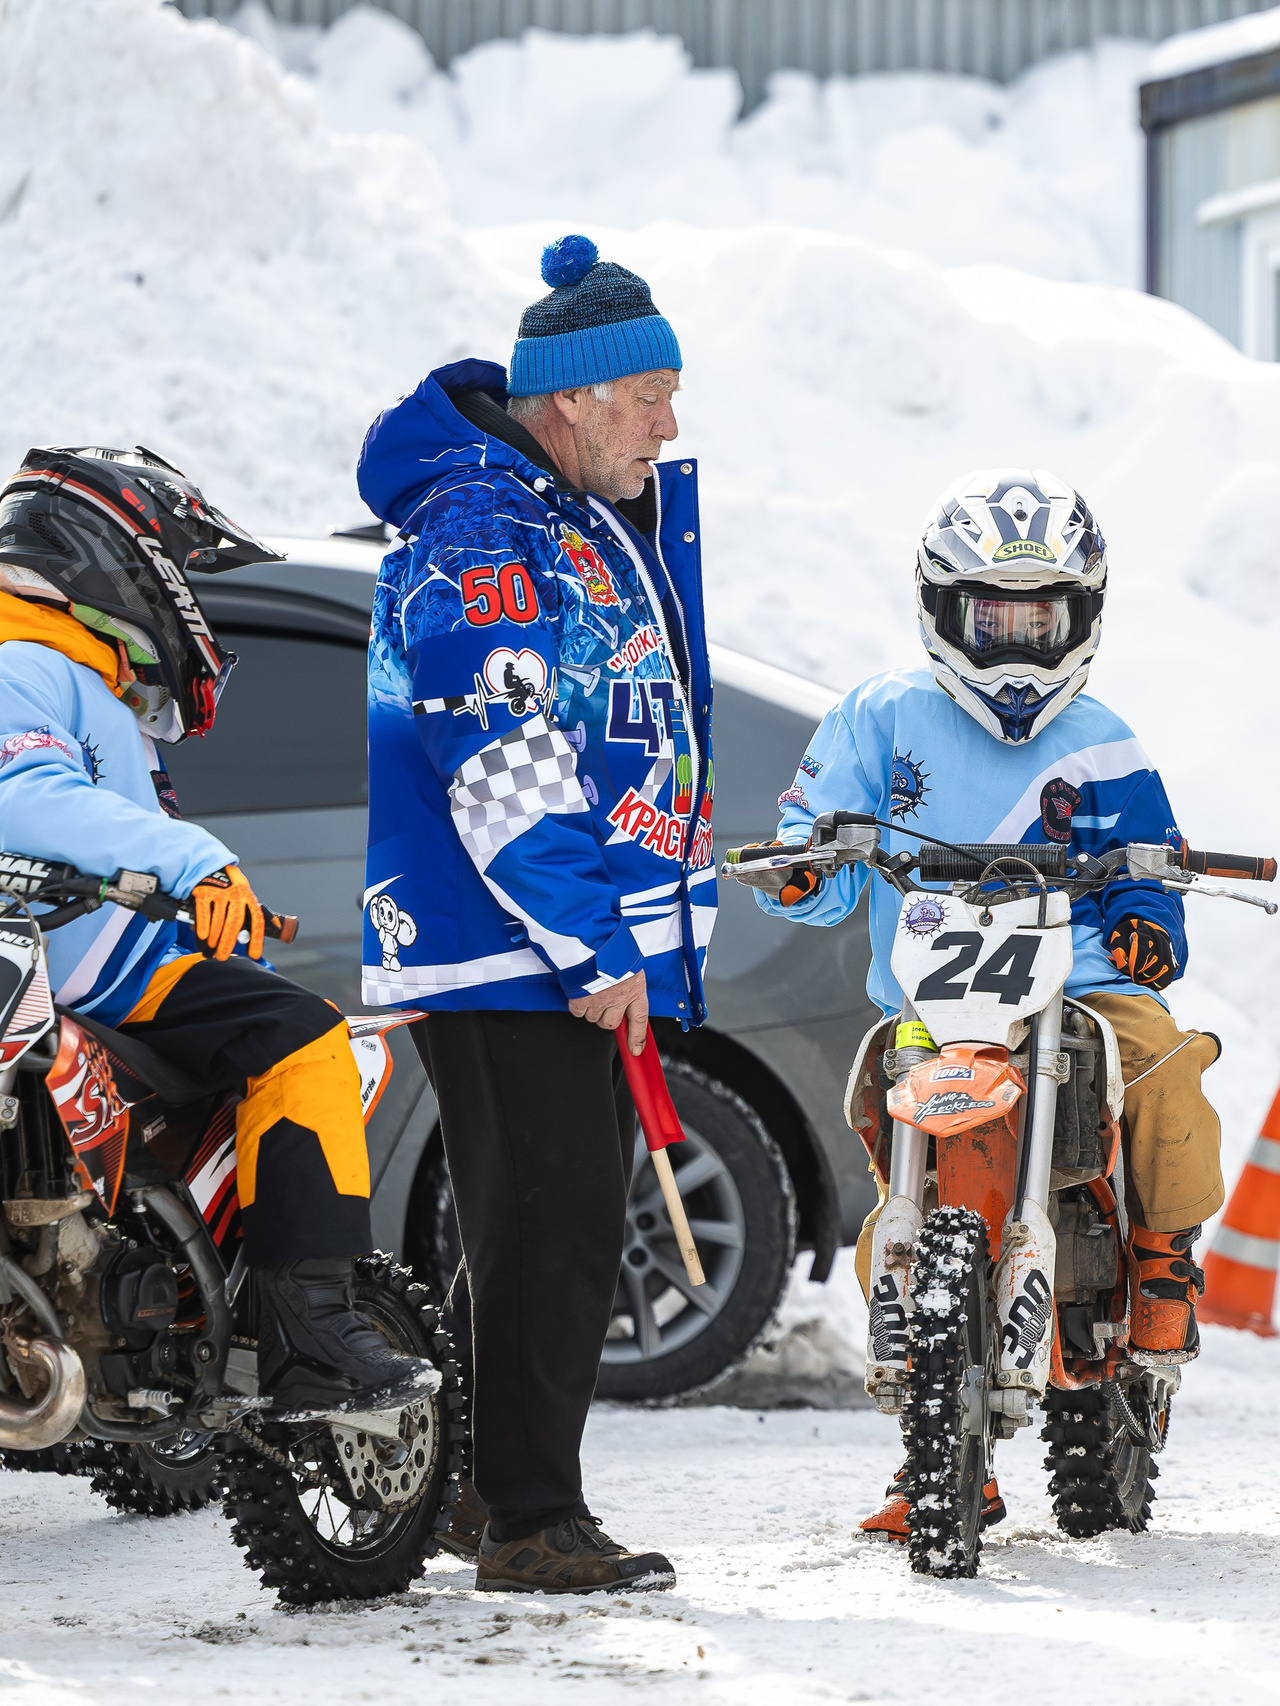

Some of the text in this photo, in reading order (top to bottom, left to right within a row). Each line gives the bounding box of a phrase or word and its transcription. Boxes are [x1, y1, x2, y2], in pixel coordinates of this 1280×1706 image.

[1003, 543, 1047, 557] SHOEI
[136, 533, 215, 642] LEATT
[461, 562, 539, 627] 50
[915, 931, 1043, 1004] 24
[934, 1068, 970, 1080] 100%
